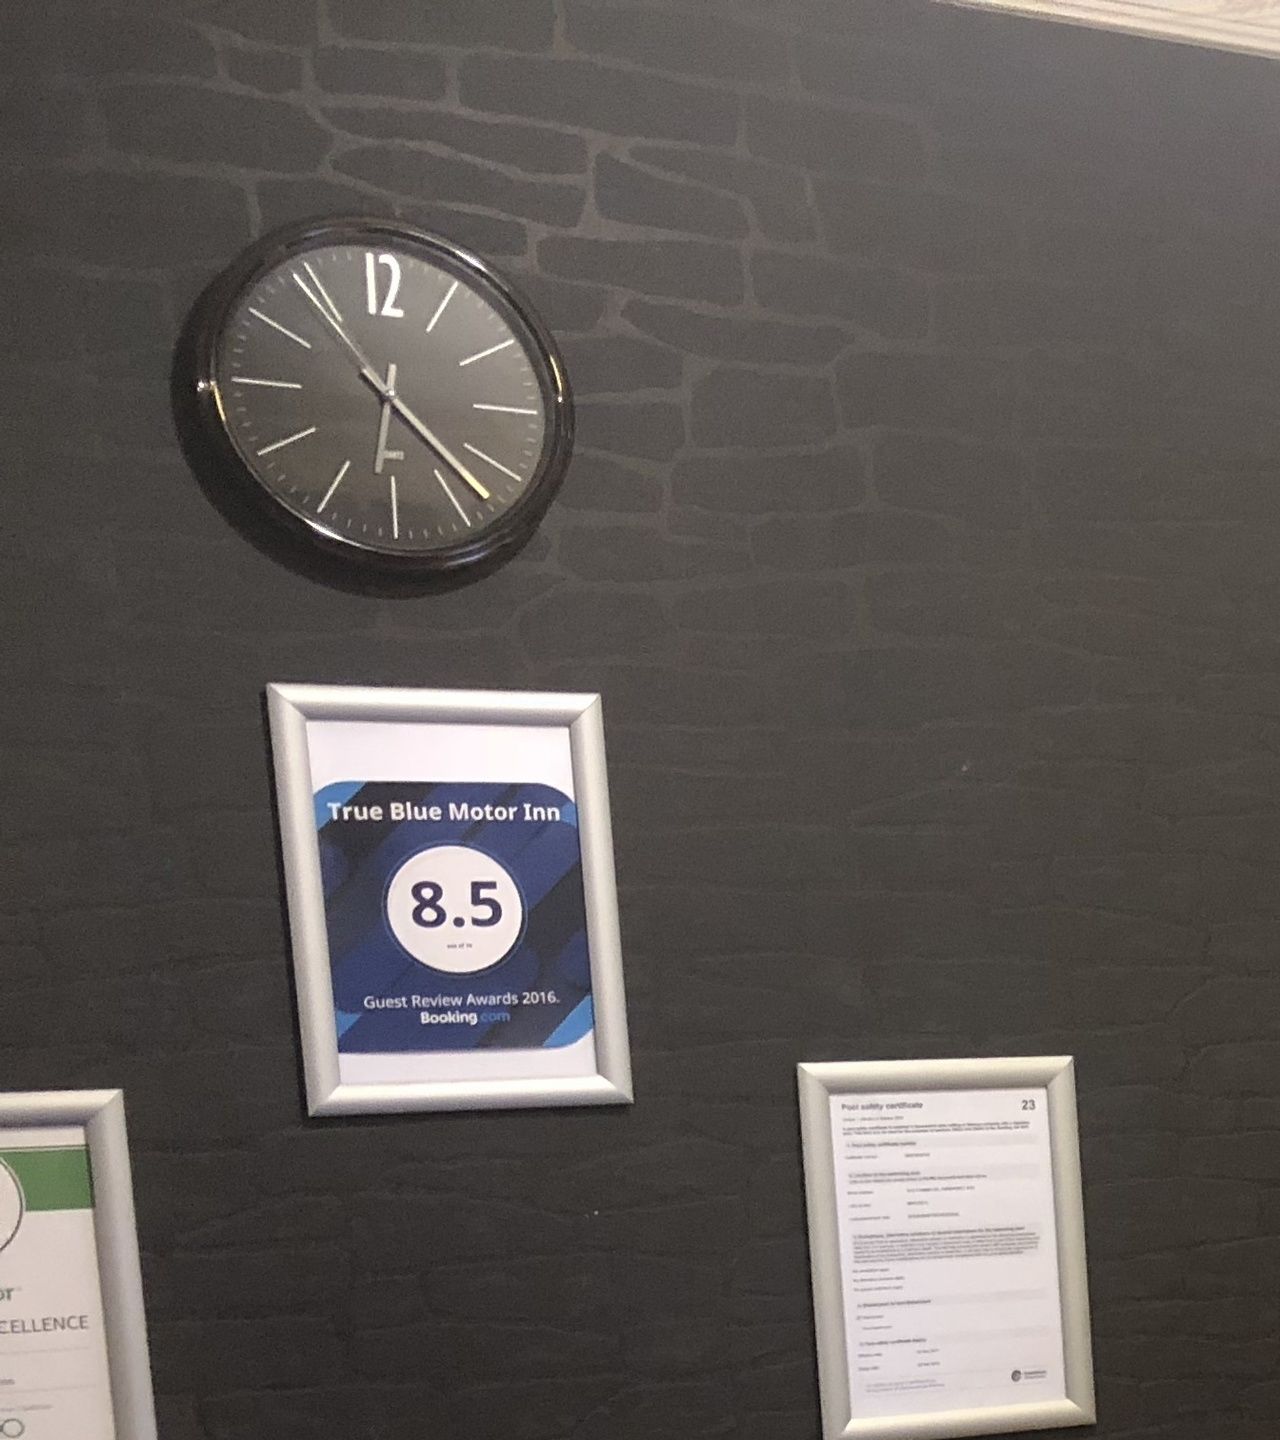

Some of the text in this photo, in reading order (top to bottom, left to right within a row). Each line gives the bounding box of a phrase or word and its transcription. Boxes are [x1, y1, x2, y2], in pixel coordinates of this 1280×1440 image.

[365, 252, 405, 318] 12
[327, 802, 561, 822] True Blue Motor Inn
[411, 880, 503, 928] 8.5
[364, 995, 409, 1010] Guest
[412, 993, 463, 1009] Review
[466, 991, 519, 1007] Awards
[1021, 1099, 1036, 1111] 23
